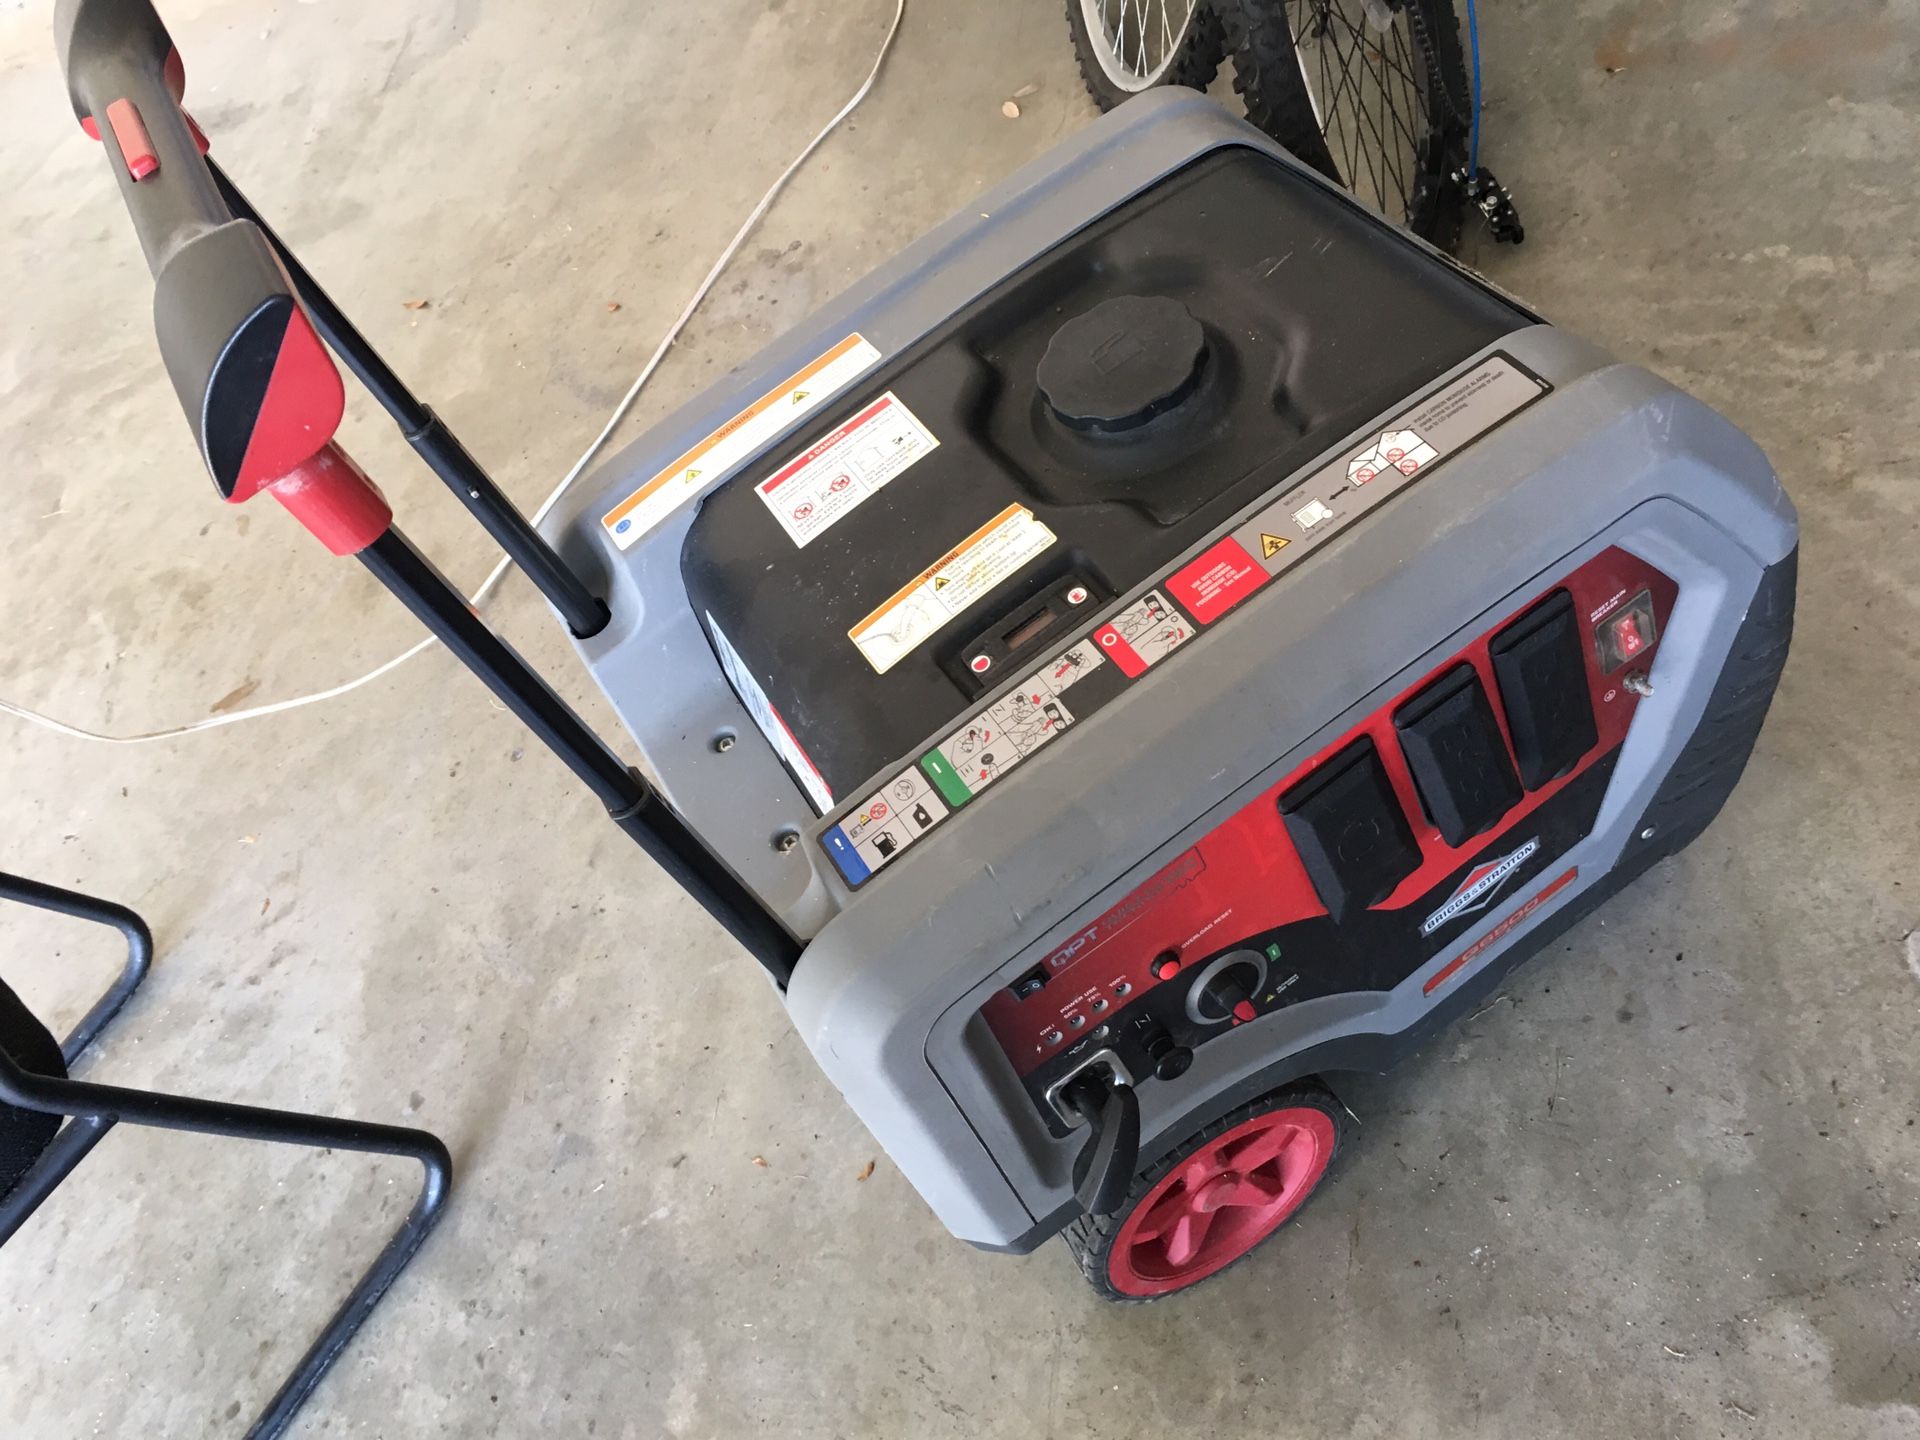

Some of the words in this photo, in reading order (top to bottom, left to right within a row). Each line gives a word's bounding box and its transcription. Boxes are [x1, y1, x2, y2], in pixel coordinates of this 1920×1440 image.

[717, 410, 753, 438] WARNING
[814, 430, 845, 454] DANGER
[923, 551, 958, 579] WARNING
[1589, 601, 1609, 617] RESET
[1609, 588, 1627, 602] MAIN
[1590, 600, 1618, 622] BREAKER
[1180, 923, 1213, 949] OVERLOAD
[1212, 907, 1233, 924] RESET
[1108, 973, 1127, 988] 100%
[1059, 995, 1084, 1013] POWER
[1083, 985, 1097, 996] USE
[1086, 991, 1101, 1002] 75%
[1063, 1007, 1079, 1019] 50%
[1038, 1023, 1055, 1036] OK!
